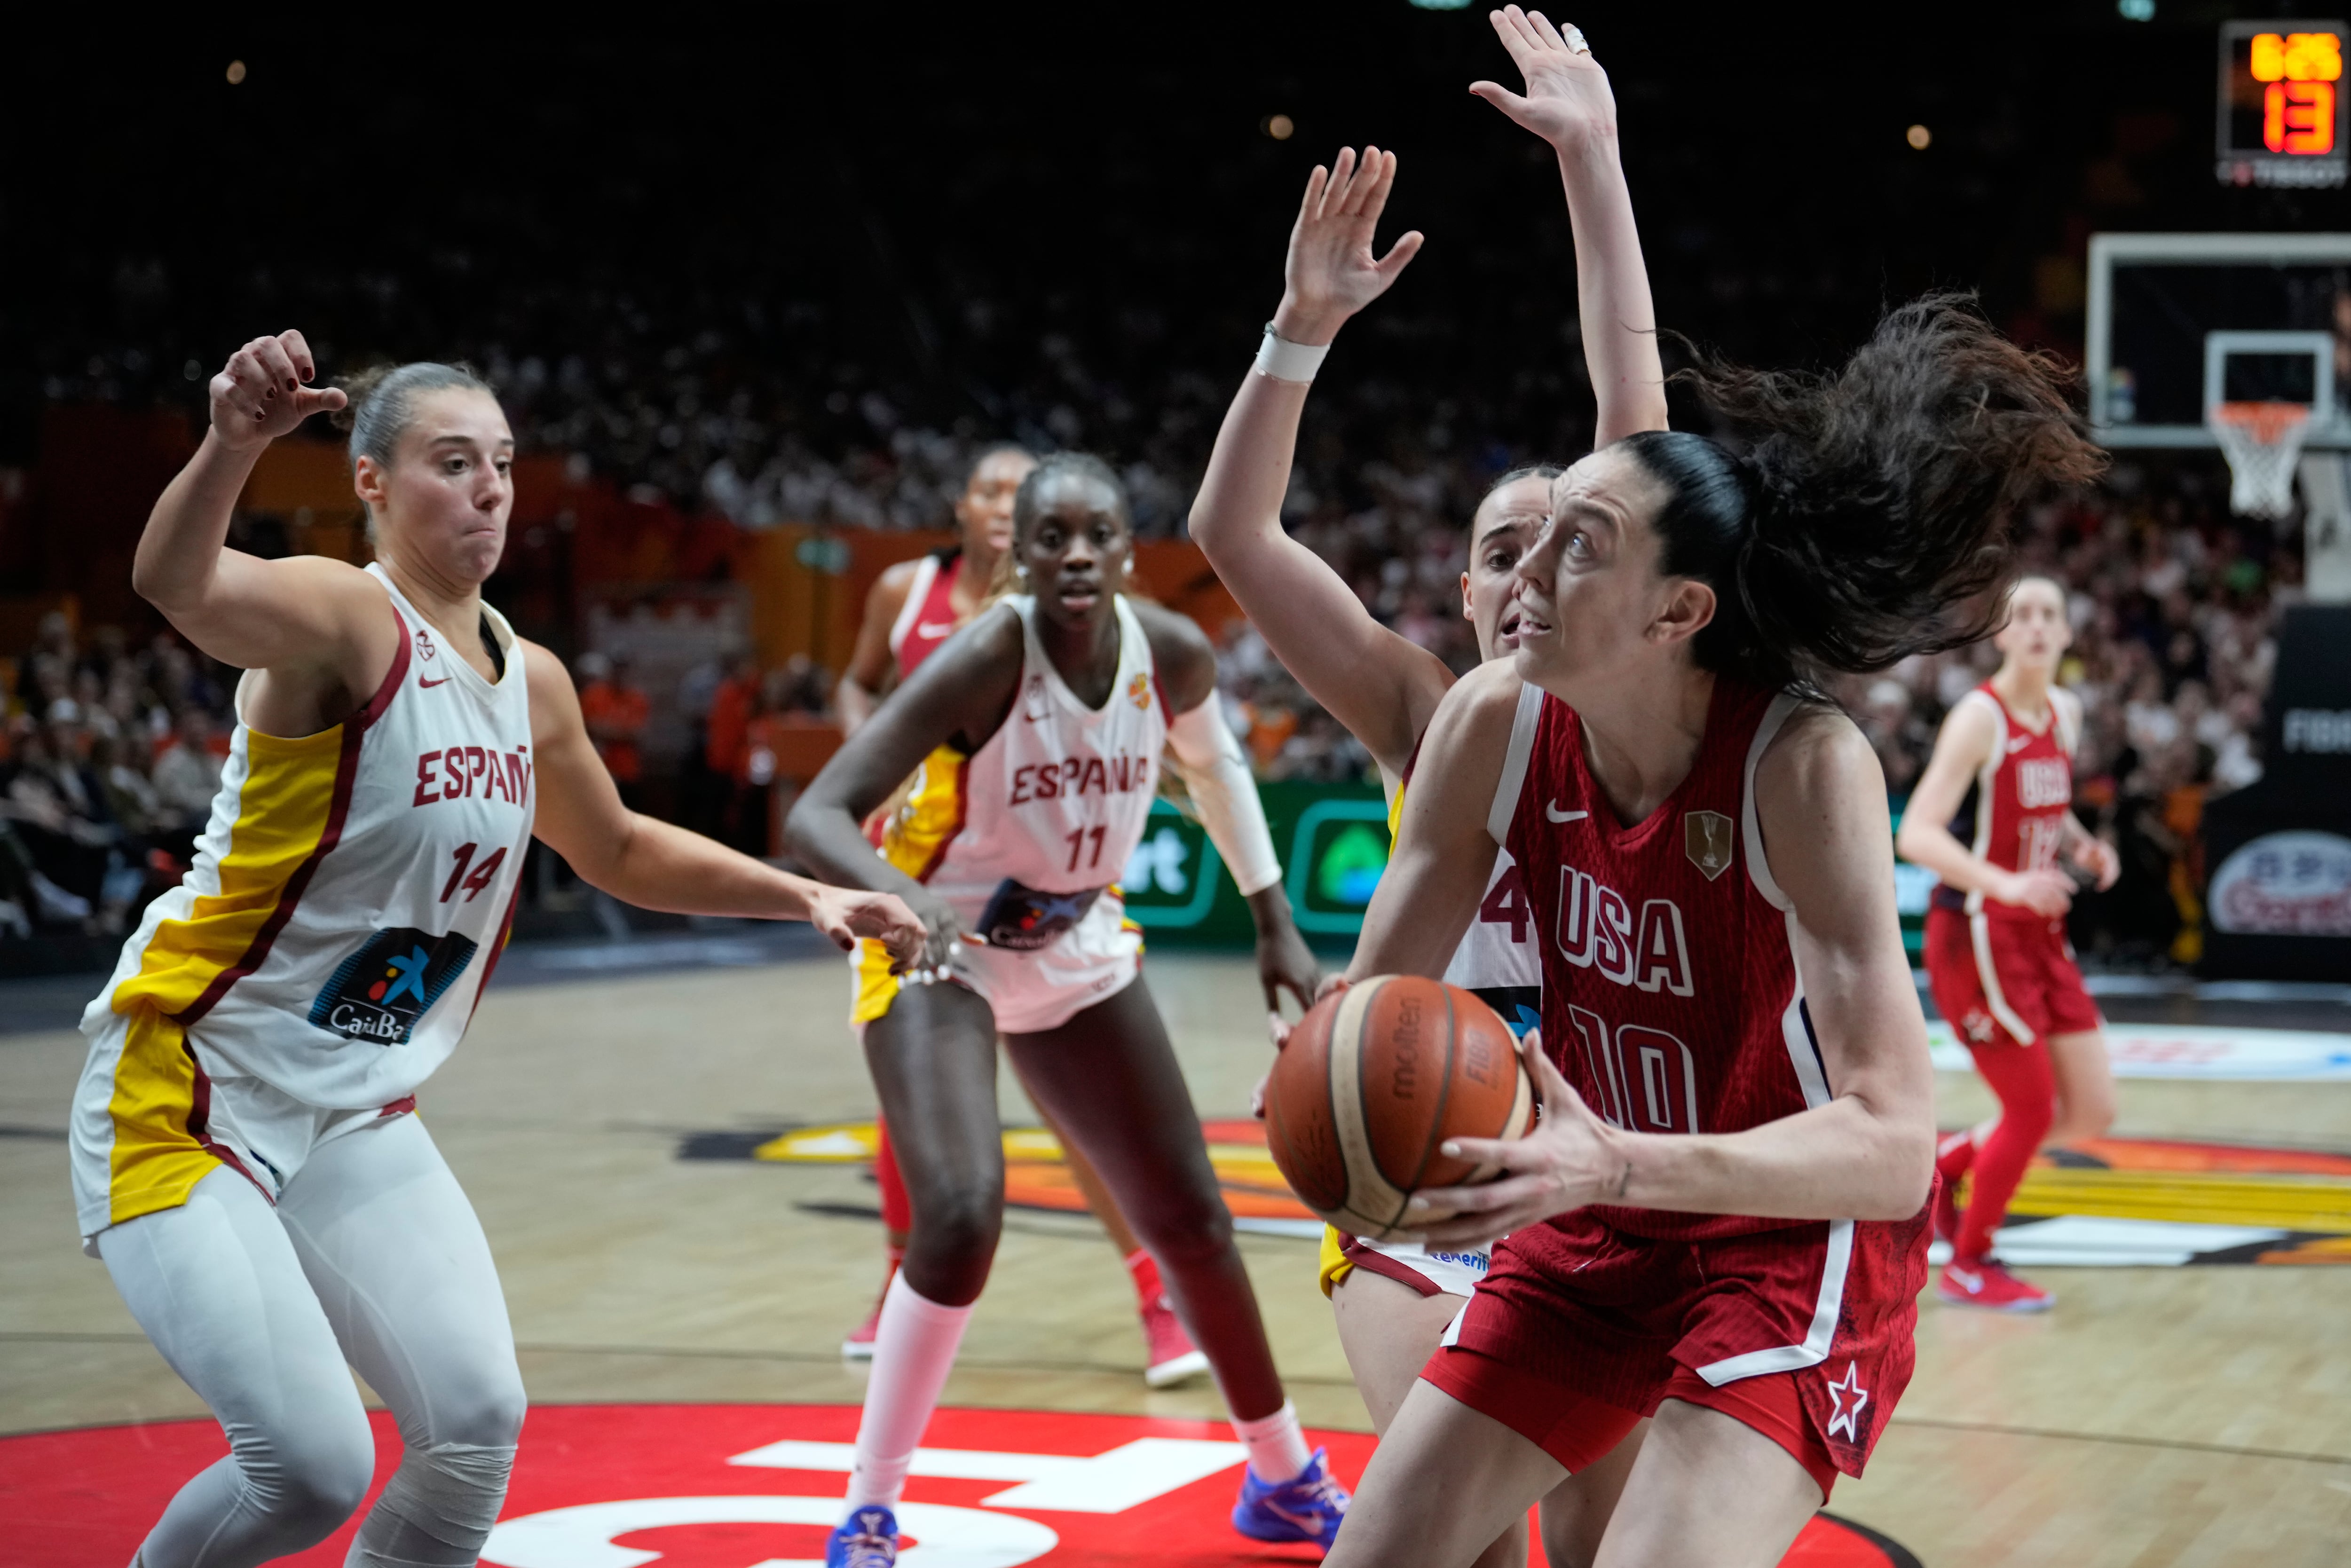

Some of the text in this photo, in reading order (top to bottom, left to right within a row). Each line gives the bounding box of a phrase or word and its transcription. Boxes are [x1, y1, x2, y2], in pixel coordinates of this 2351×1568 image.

[2264, 80, 2335, 154] 13
[439, 842, 507, 903] 14
[1066, 825, 1107, 873] 11
[1480, 866, 1530, 943] 4
[1556, 864, 1694, 997] USA
[1391, 995, 1421, 1100] molten
[1568, 1003, 1699, 1135] 10
[1429, 1251, 1490, 1271] tenerif
